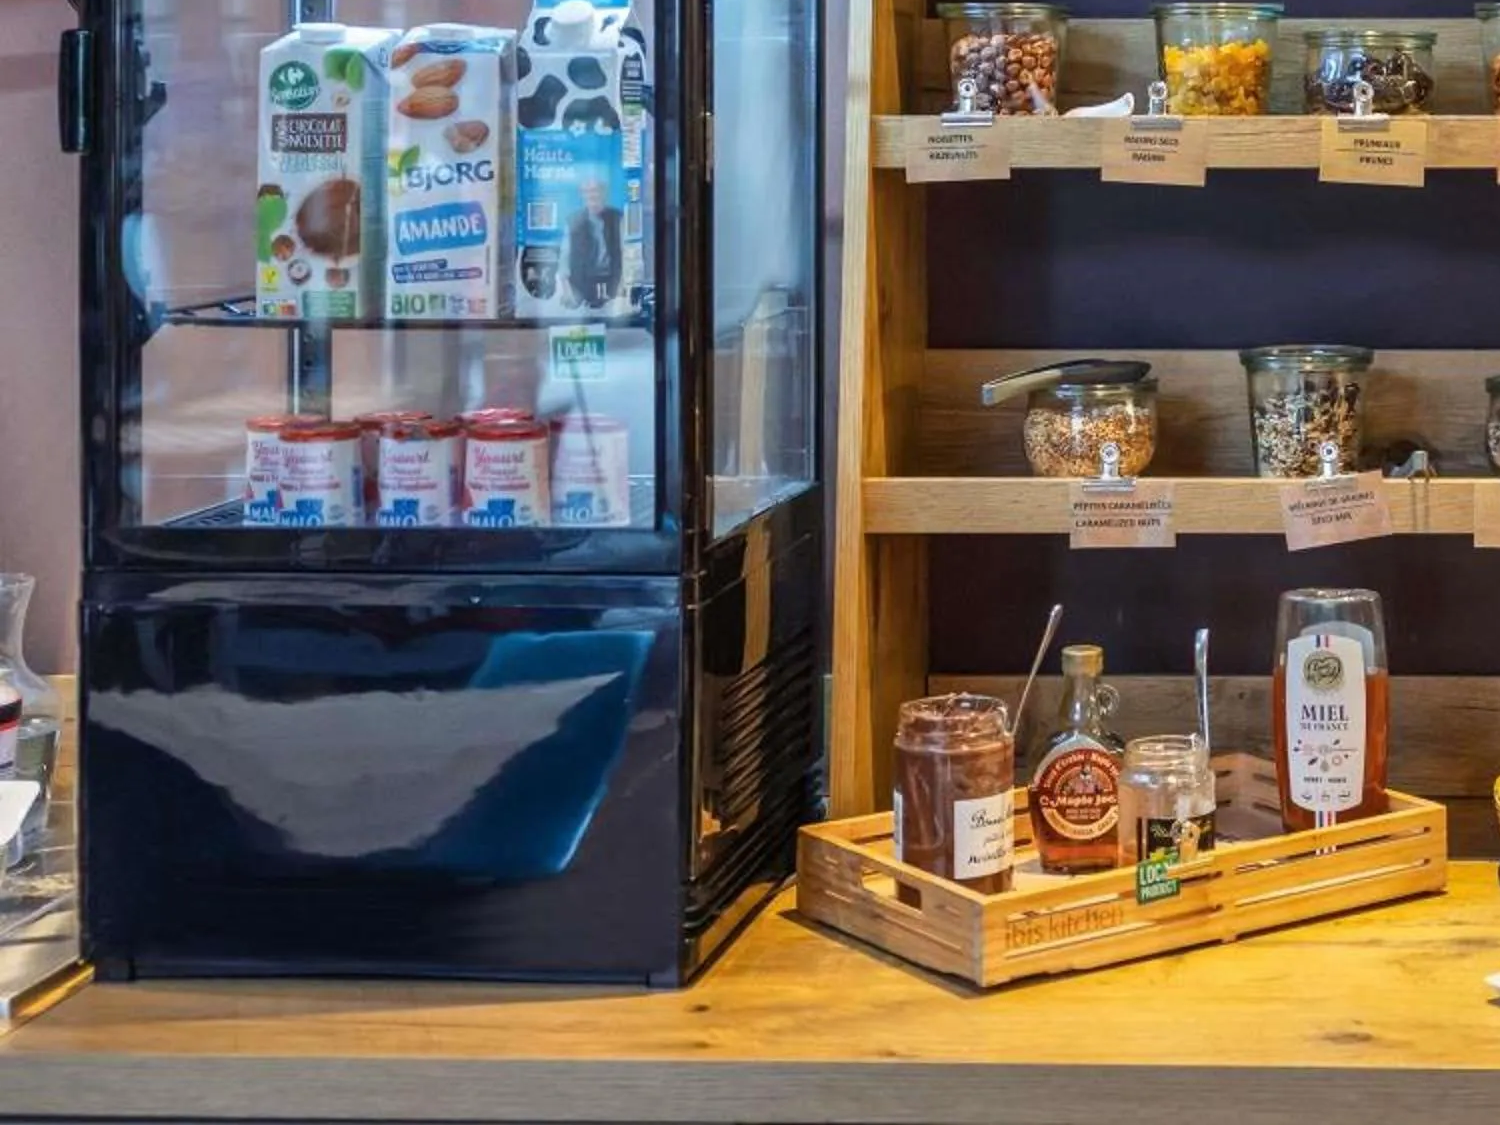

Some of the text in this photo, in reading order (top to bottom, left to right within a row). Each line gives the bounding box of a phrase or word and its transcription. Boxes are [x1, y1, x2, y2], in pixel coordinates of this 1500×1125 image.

[400, 212, 486, 244] AMANDE
[391, 293, 427, 316] BIO
[557, 342, 602, 361] LOCAL
[251, 506, 278, 523] MAL
[378, 510, 420, 526] MALO
[470, 510, 517, 526] MALO
[1301, 704, 1349, 722] MIEL
[1312, 723, 1349, 732] FRANCE
[1004, 903, 1125, 948] ibis kitchen
